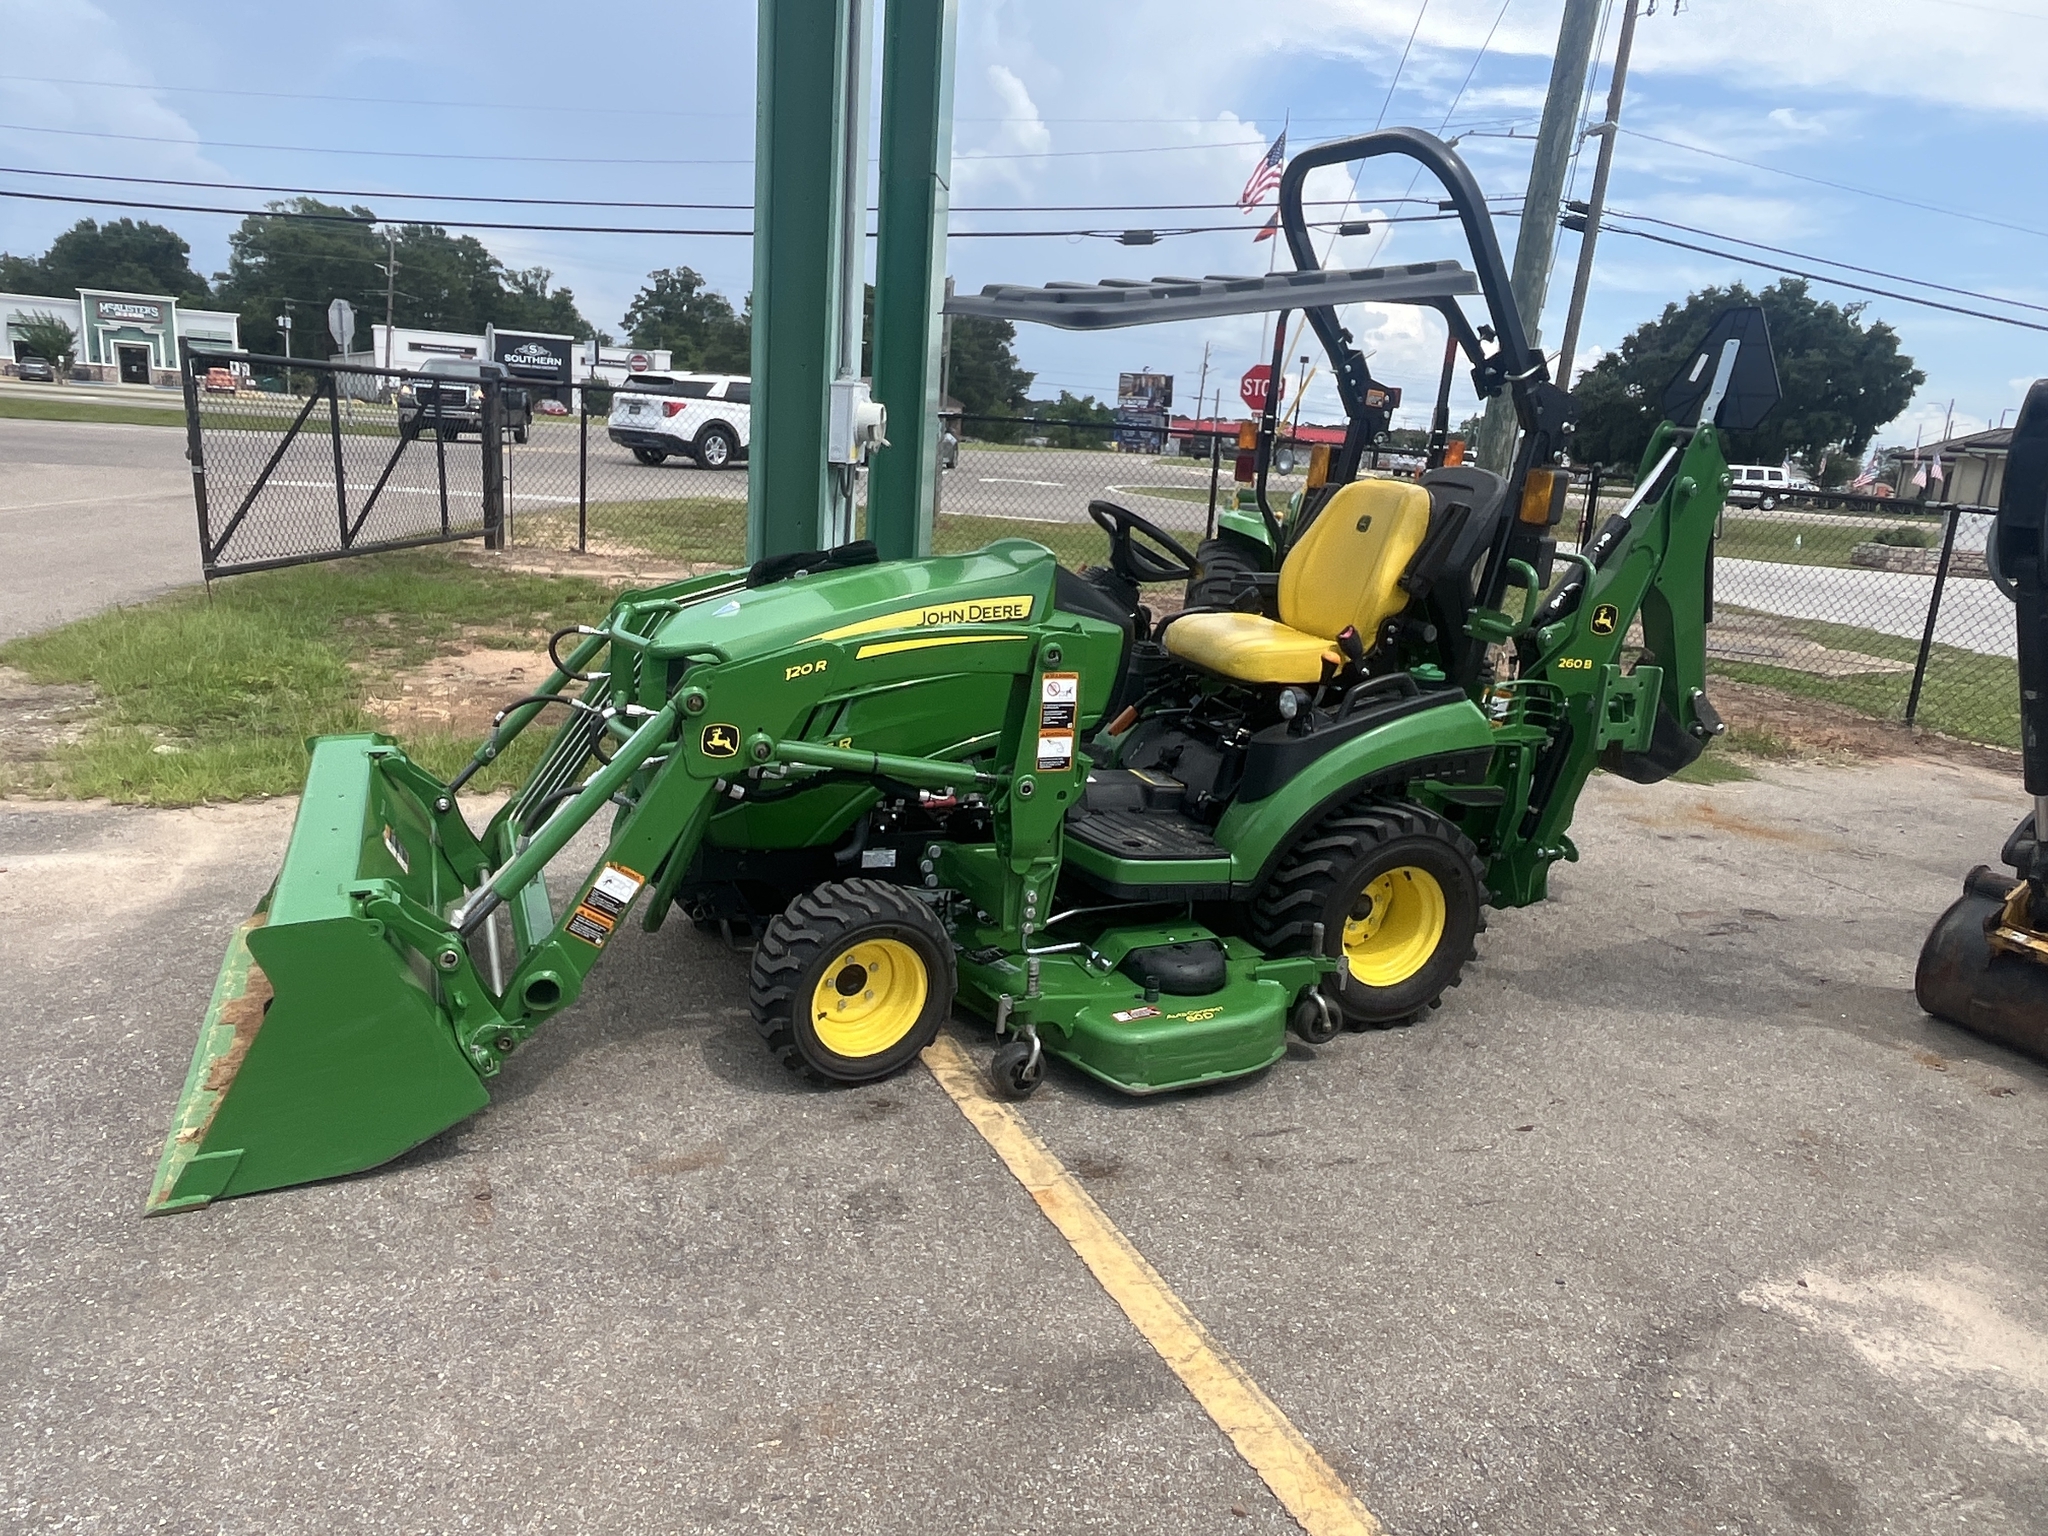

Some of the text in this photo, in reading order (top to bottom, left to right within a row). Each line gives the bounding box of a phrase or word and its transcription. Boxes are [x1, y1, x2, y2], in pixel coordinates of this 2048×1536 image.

[529, 345, 538, 354] S
[504, 354, 562, 366] SOUTHERN
[917, 604, 1023, 626] JOHN DEERE
[1558, 658, 1592, 669] 260 B
[785, 659, 828, 681] 120 R
